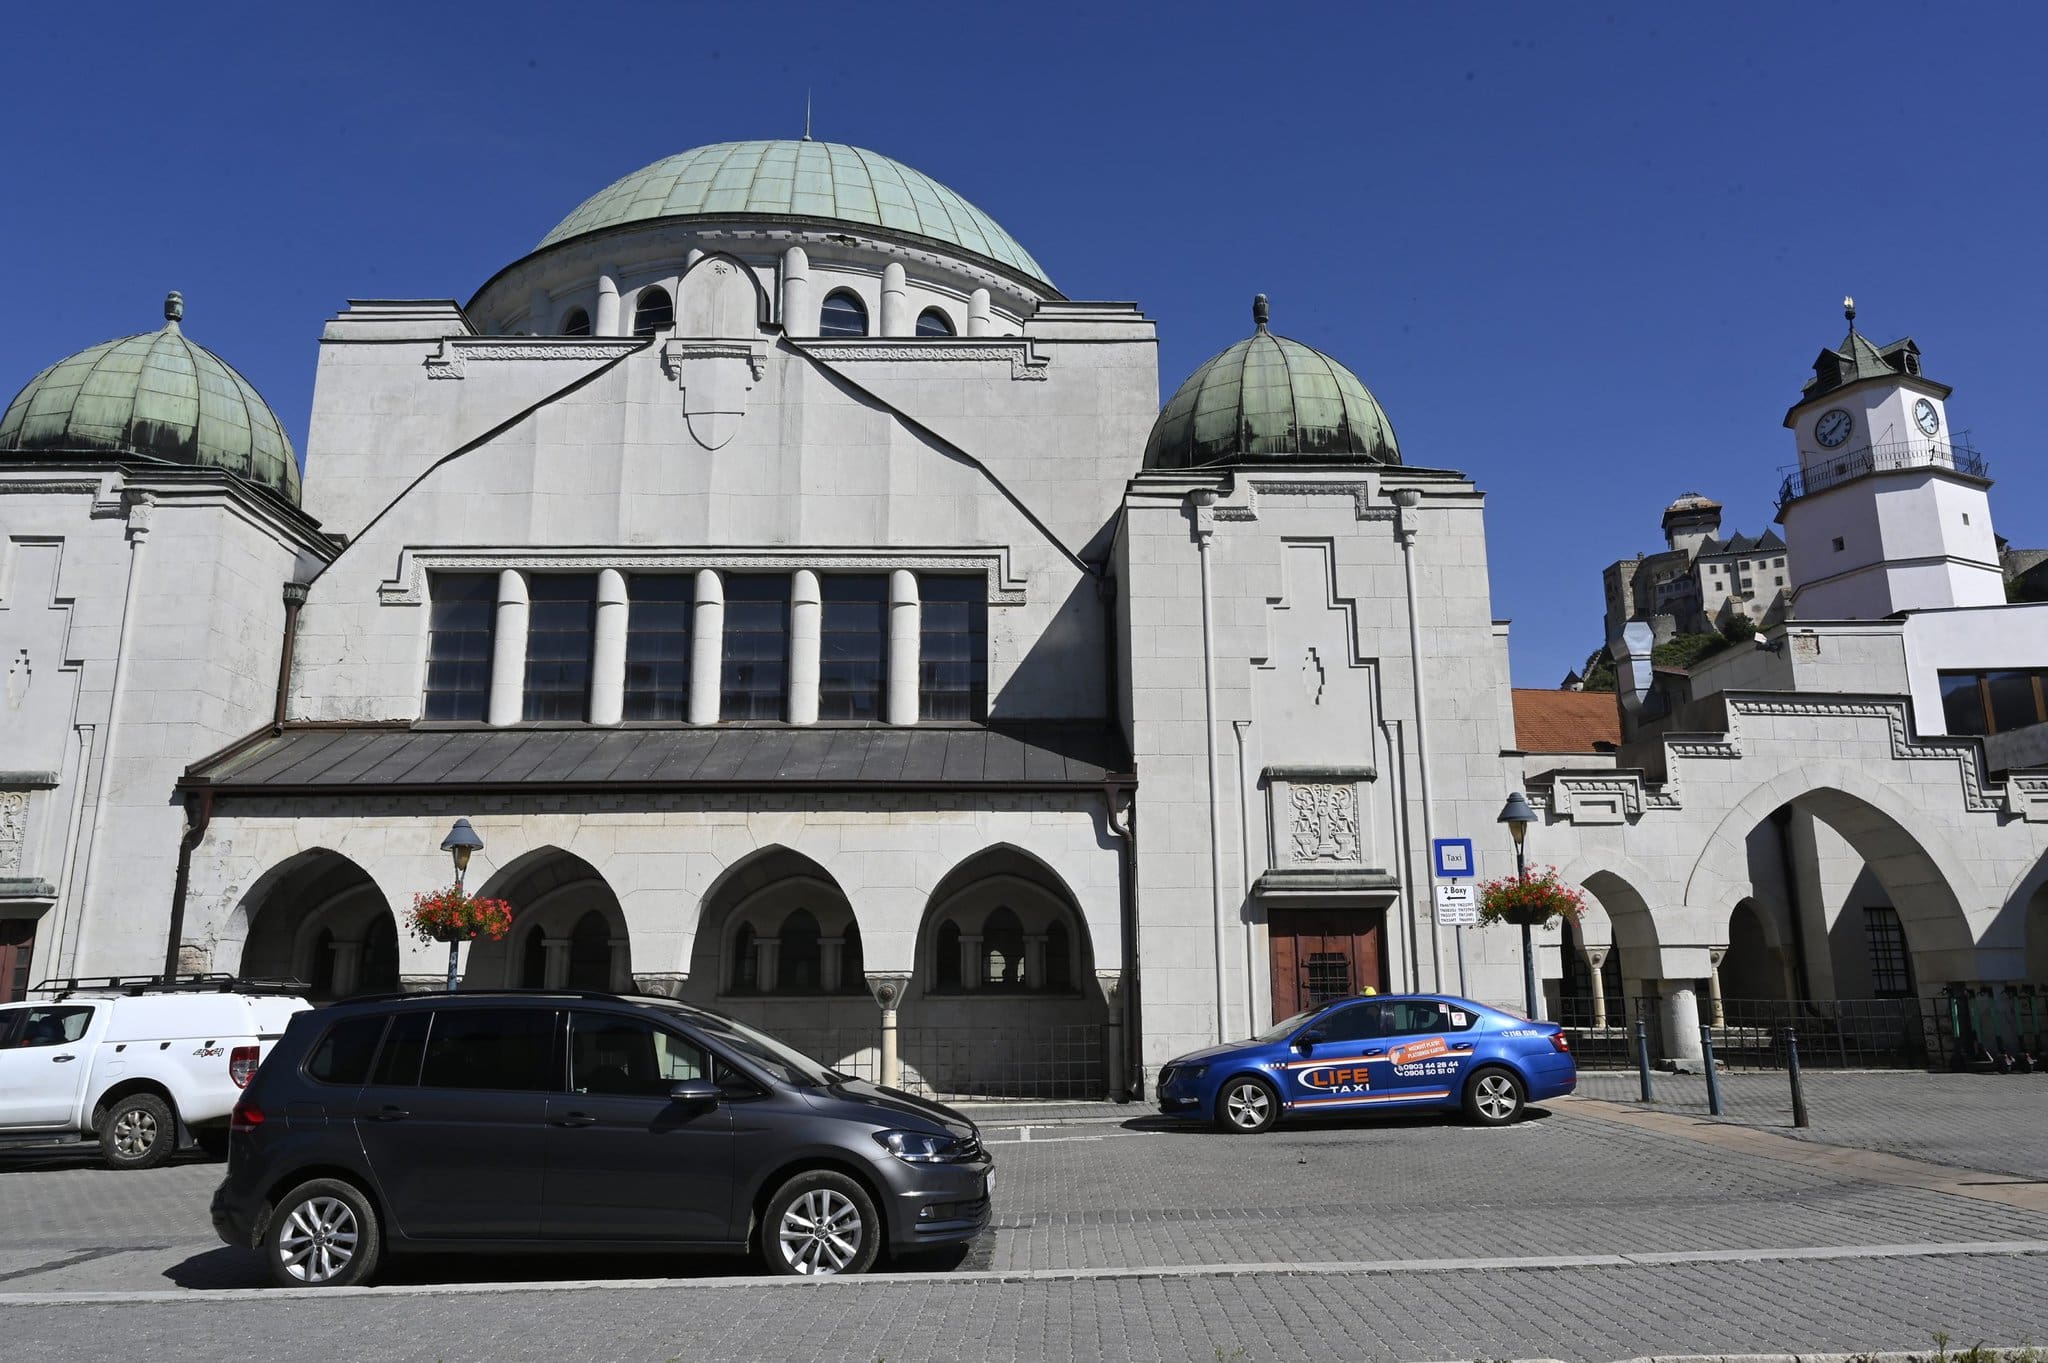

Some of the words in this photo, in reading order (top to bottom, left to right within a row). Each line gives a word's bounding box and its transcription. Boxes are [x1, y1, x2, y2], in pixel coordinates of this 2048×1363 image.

[1444, 886, 1448, 894] 2
[1450, 886, 1467, 895] Boxy
[1403, 1063, 1424, 1071] 0903
[1448, 1060, 1459, 1068] 44
[1313, 1067, 1370, 1086] LIFE
[1403, 1069, 1425, 1077] 0908
[1329, 1083, 1370, 1094] TAXI
